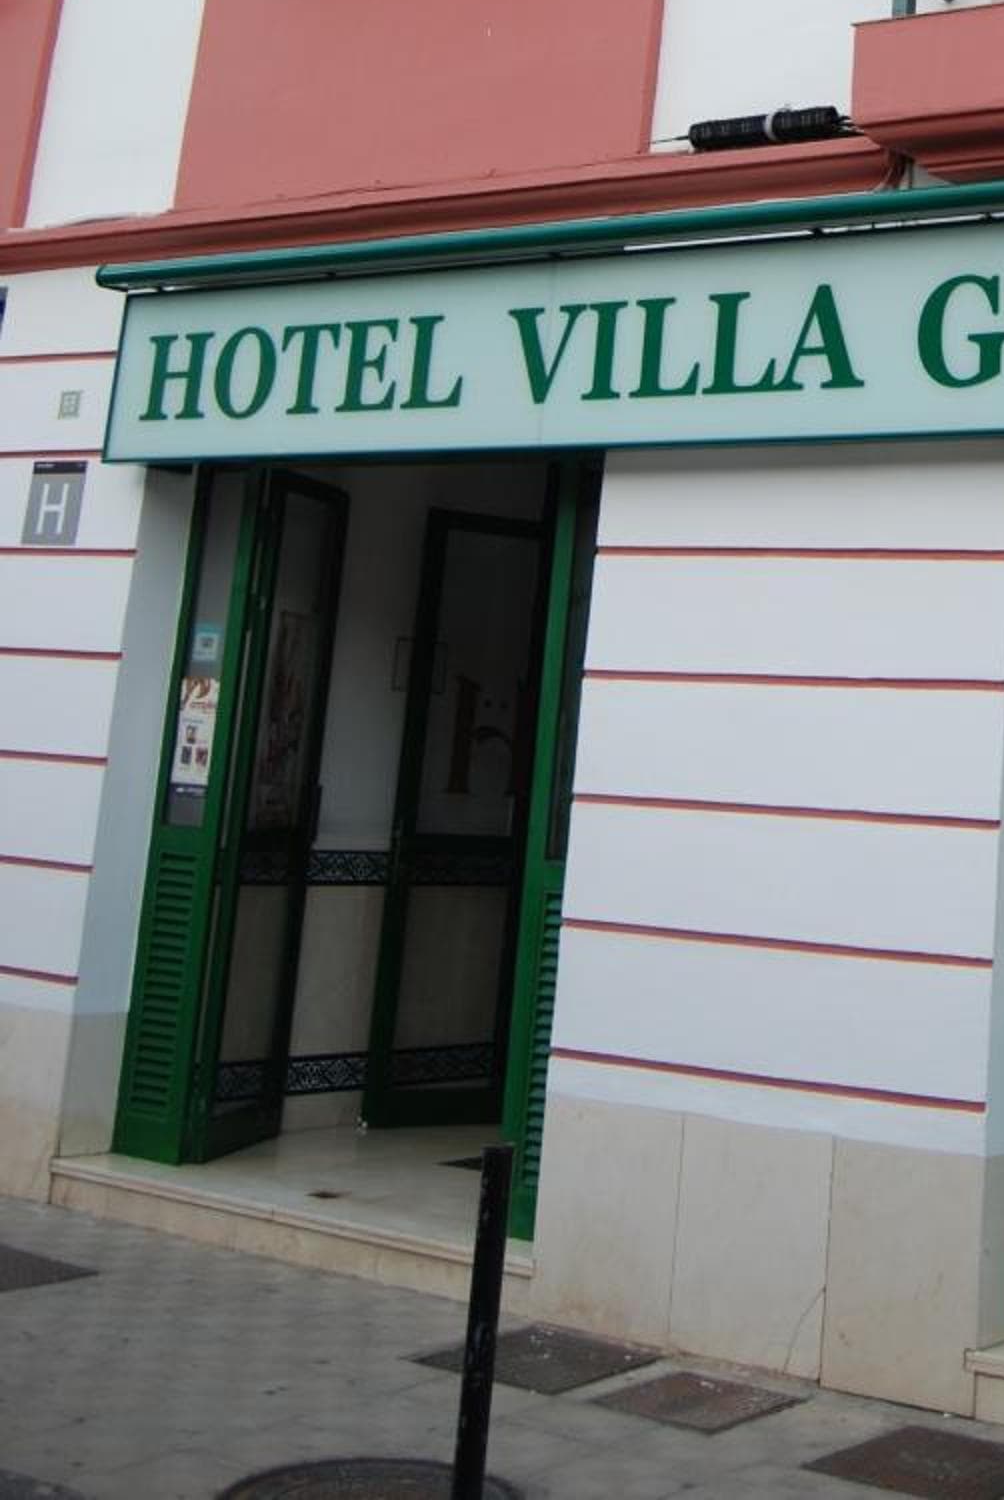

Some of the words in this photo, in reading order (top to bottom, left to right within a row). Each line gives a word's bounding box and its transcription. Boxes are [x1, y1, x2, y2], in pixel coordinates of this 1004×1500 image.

[139, 315, 463, 421] HOTEL
[508, 284, 865, 404] VILLA
[35, 483, 69, 534] H
